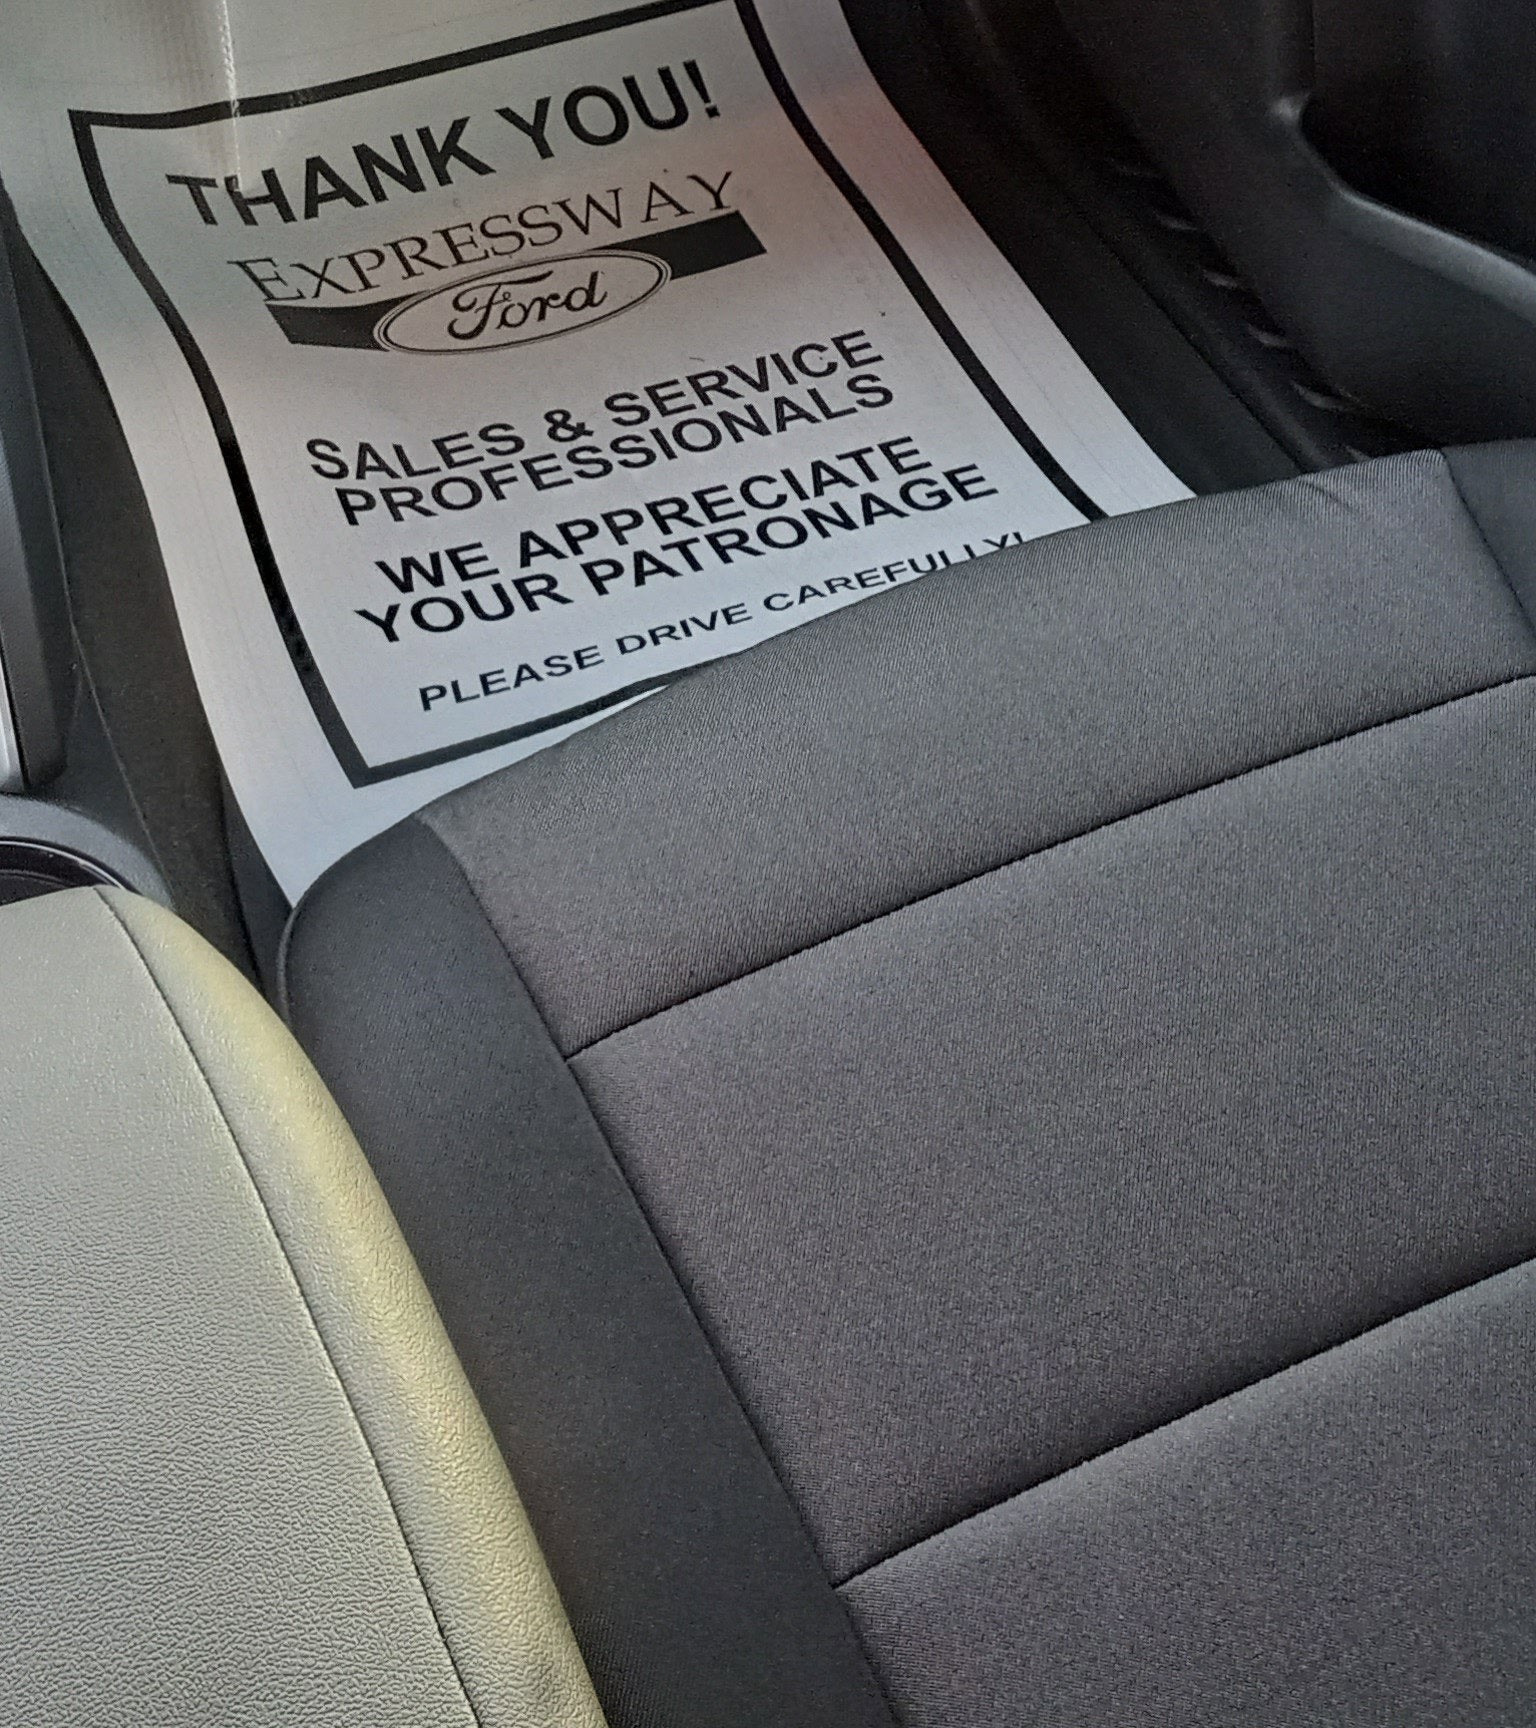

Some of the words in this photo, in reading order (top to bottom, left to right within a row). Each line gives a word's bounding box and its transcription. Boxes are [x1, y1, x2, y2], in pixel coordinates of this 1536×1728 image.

[166, 115, 497, 228] THANK
[494, 58, 722, 160] YOU!
[227, 170, 733, 303] EXPRESSWAY
[445, 268, 608, 341] Ford
[304, 420, 526, 482] SALES
[543, 408, 595, 443] &
[604, 328, 885, 430] SERVICE
[333, 372, 896, 527] PROFESSIONALS
[355, 572, 574, 646] YOUR
[585, 463, 1001, 597] PATRONAGE
[374, 540, 503, 594] WE
[516, 435, 934, 570] APPRECIATE
[416, 645, 606, 712] PLEASE
[614, 602, 754, 656] DRIVE
